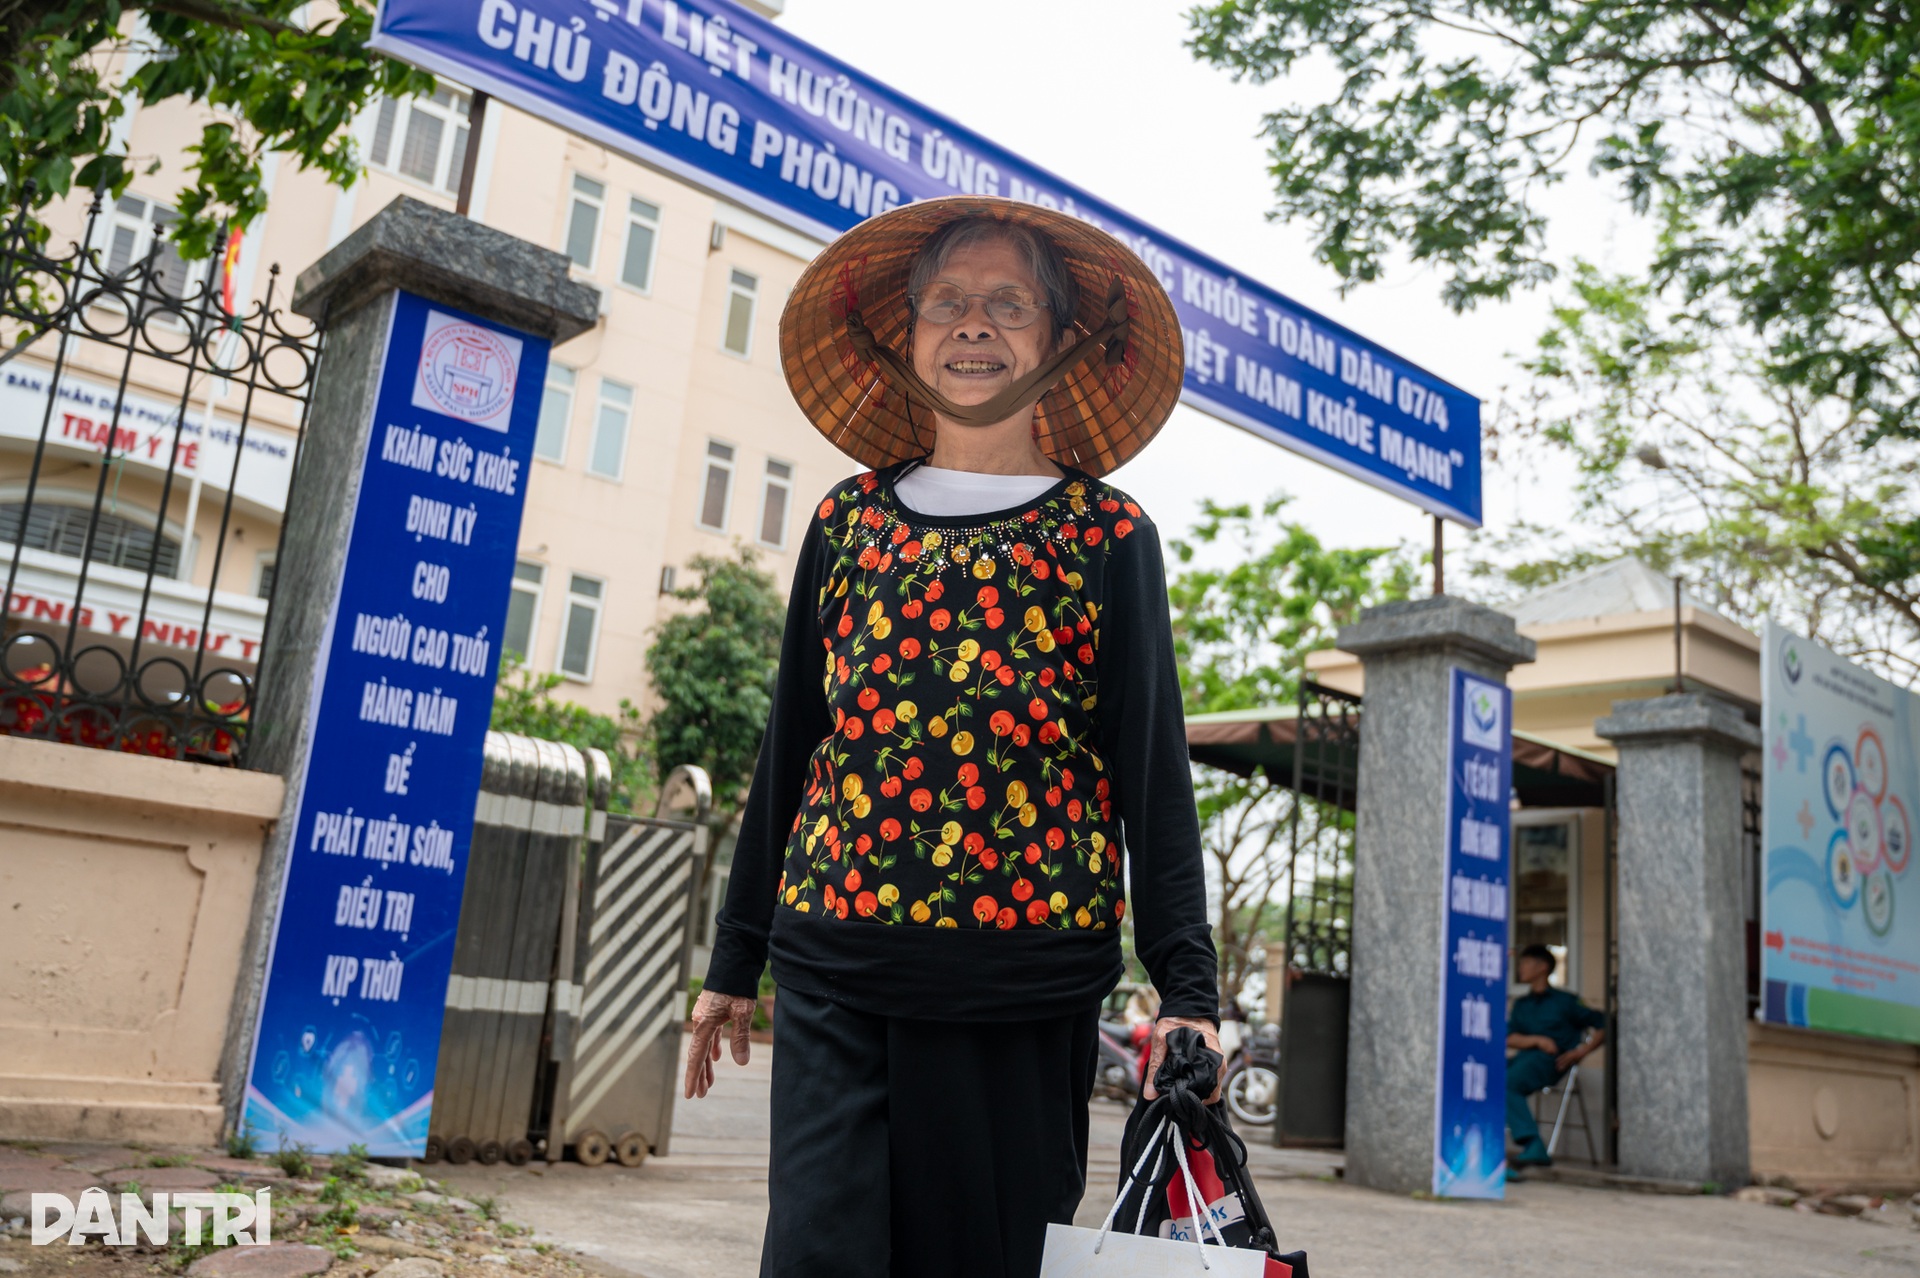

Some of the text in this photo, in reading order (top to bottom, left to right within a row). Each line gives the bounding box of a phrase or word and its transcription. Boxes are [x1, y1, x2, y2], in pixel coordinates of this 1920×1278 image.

[477, 0, 591, 83] CHỦ
[602, 49, 740, 155] ĐỘNG
[750, 119, 900, 218] PHÒNG
[662, 0, 999, 197] LIỆT HƯỞNG ỨNG
[7, 374, 42, 391] BAN
[1181, 276, 1259, 337] KHỎE
[1264, 307, 1336, 376] TOÀN
[1340, 347, 1394, 405] DÂN
[1397, 376, 1449, 432] 07/4
[1235, 354, 1302, 420] NAM
[1307, 388, 1376, 455] KHỎE
[62, 412, 138, 453] TRẠM
[147, 435, 163, 459] Y
[381, 423, 520, 496] KHÁM SỨC KHỎE
[405, 494, 478, 546] ĐỊNH KỲ
[412, 560, 450, 604] CHO
[108, 611, 130, 634] Y
[141, 620, 230, 651] NHƯ
[352, 612, 490, 678] NGƯỜI CAO TUỔI
[359, 675, 458, 737] HÀNG NĂM
[384, 741, 417, 796] ĐỂ
[310, 806, 455, 876] PHÁT HIỆN SỚM,
[383, 890, 415, 943] TRỊ
[321, 950, 404, 1007] KỊP THỜI
